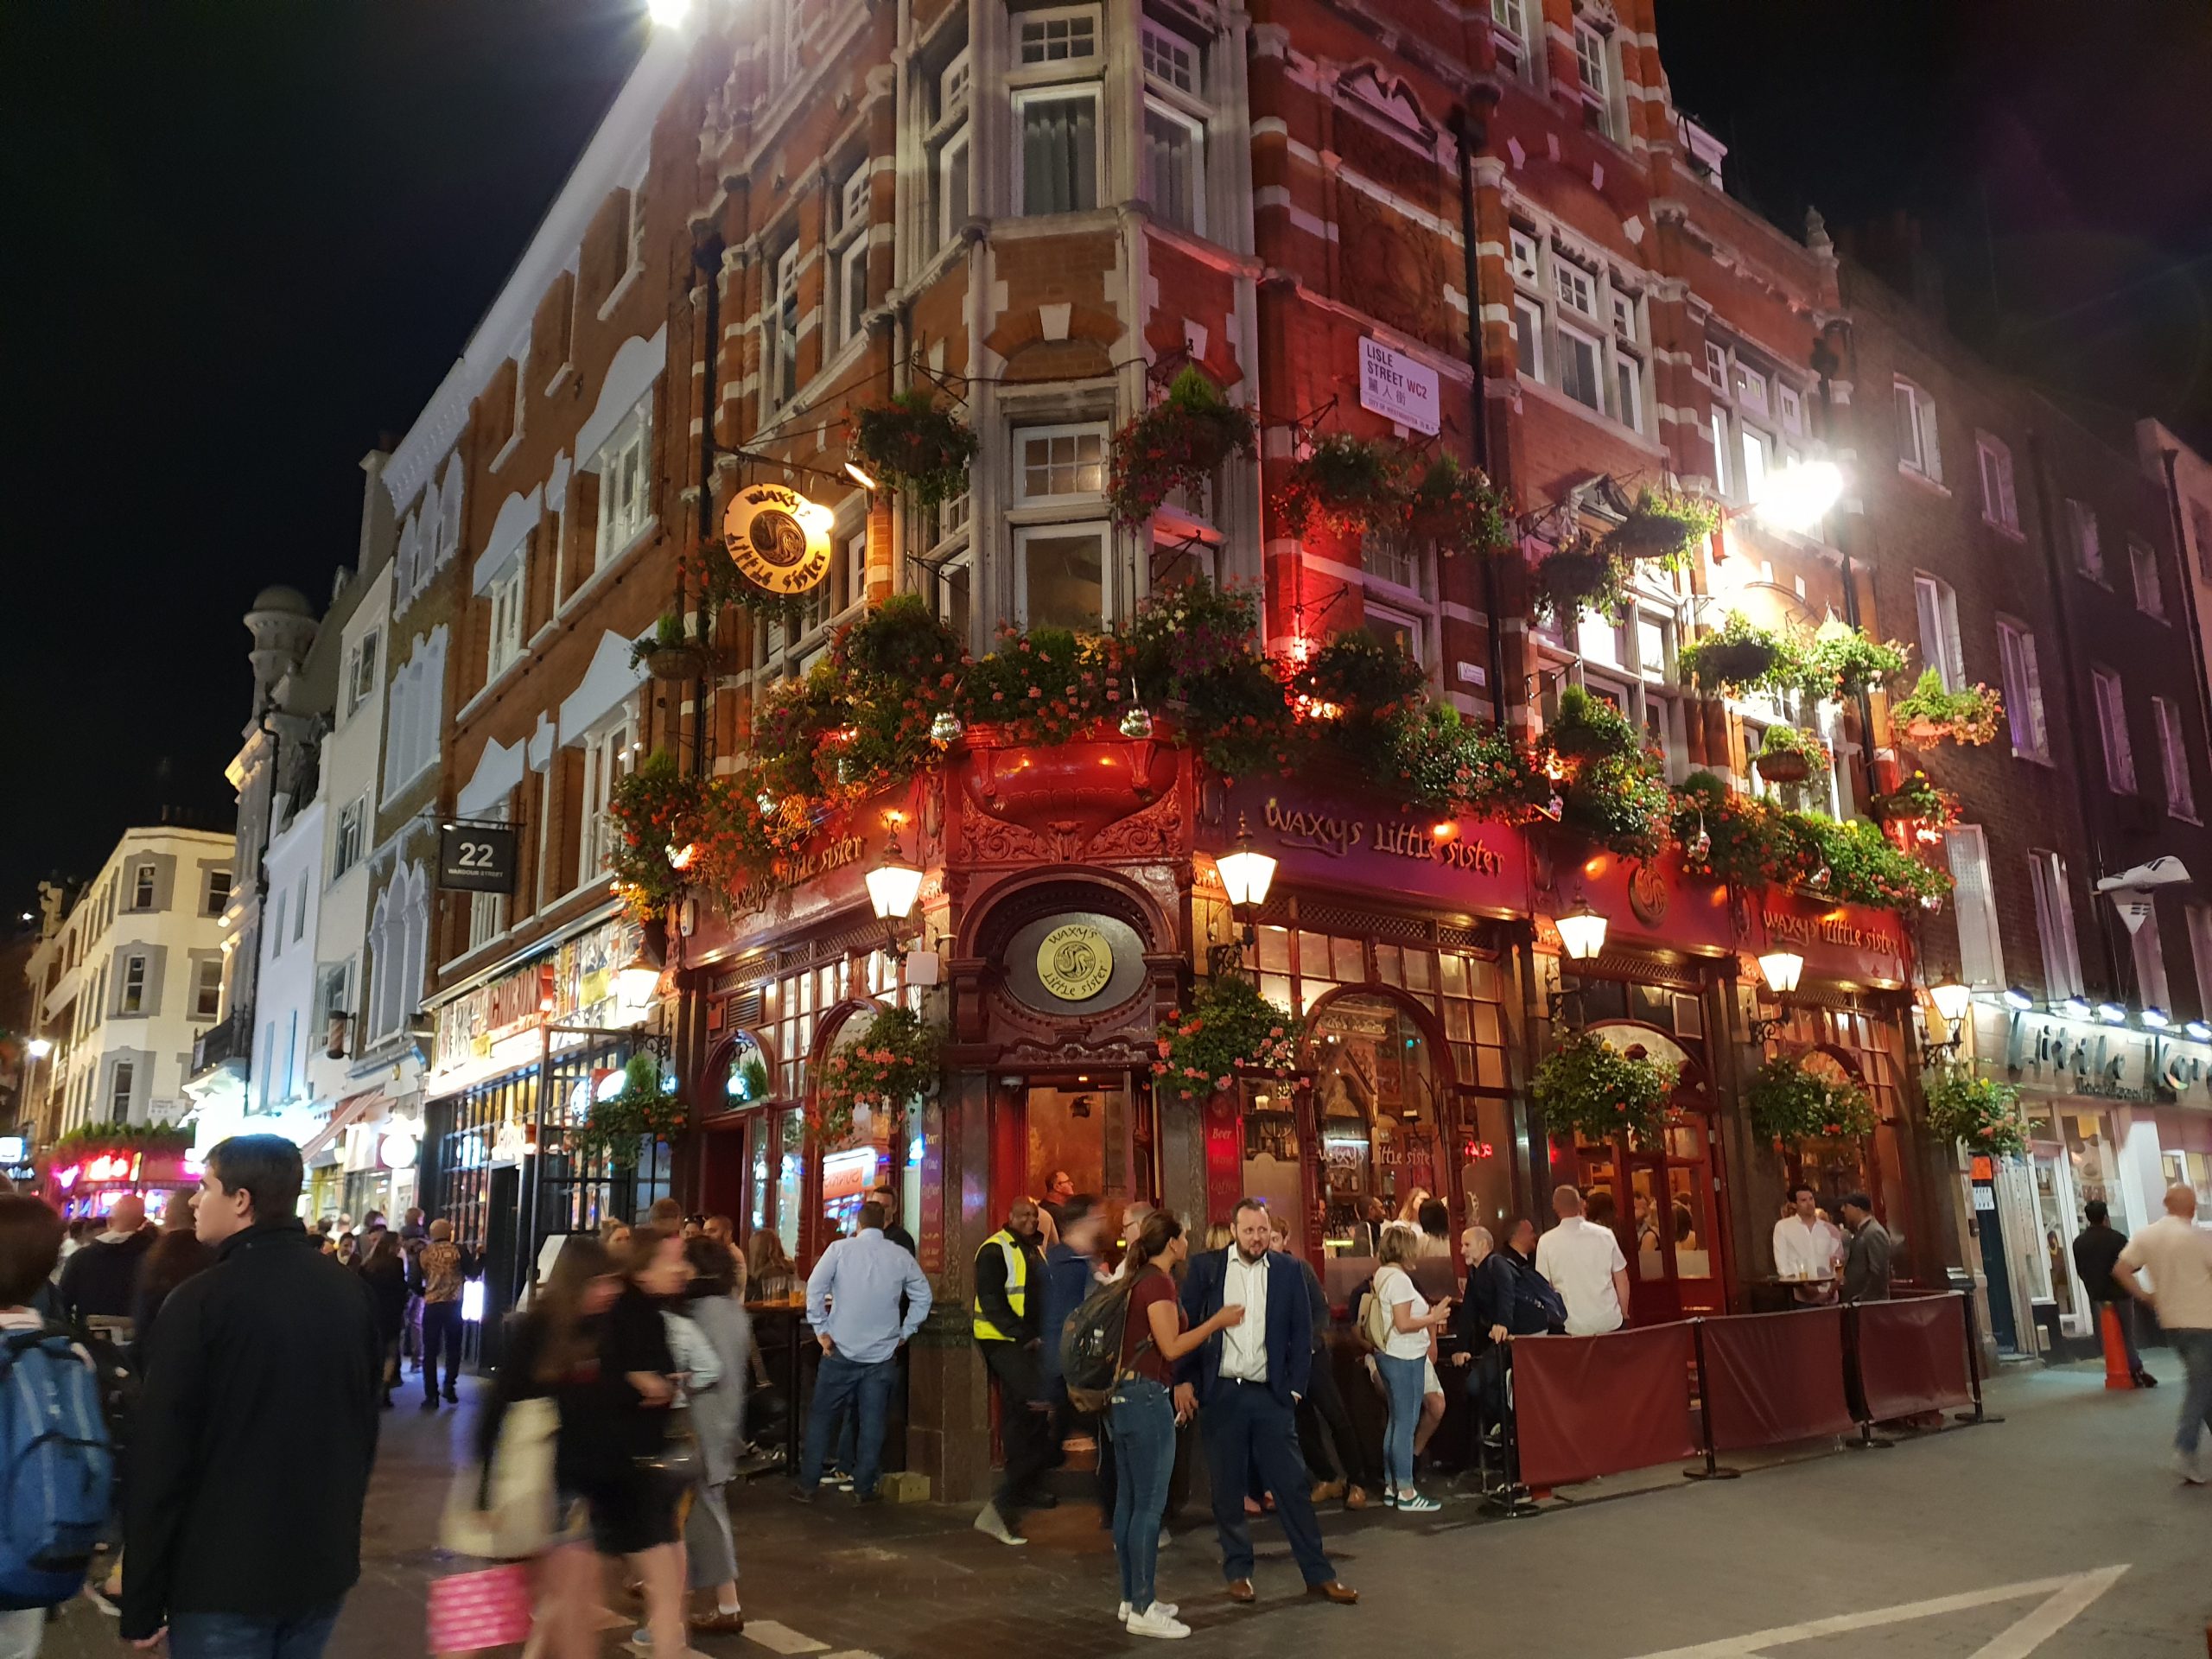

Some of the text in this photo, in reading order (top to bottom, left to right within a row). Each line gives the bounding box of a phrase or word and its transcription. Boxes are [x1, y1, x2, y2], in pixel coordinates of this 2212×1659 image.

[1367, 344, 1394, 368] LISLE
[1367, 359, 1427, 400] STREET WC2
[459, 842, 493, 868] 22
[2007, 1011, 2212, 1091] Little Kor
[1212, 1128, 1232, 1141] Beer
